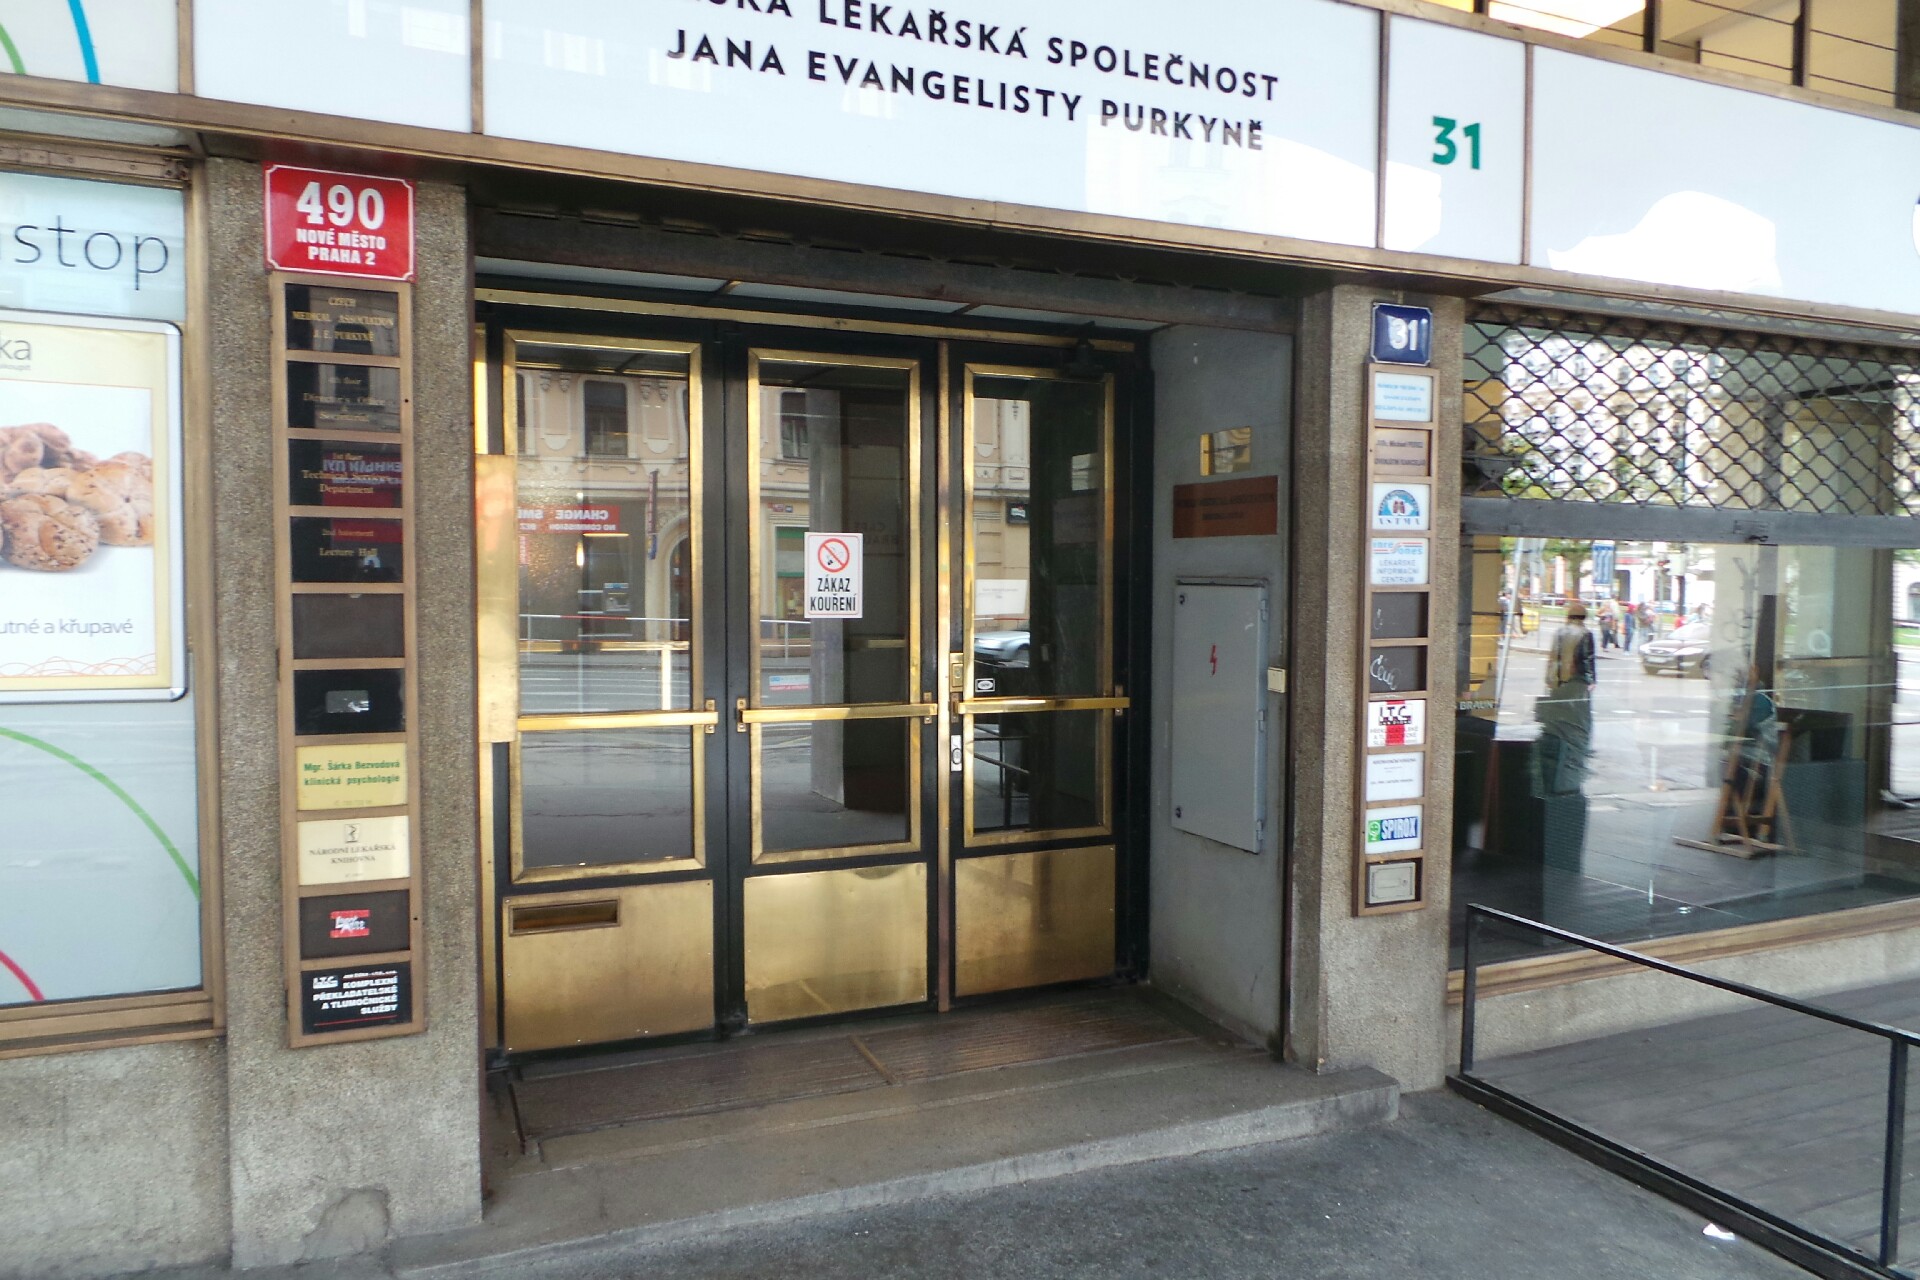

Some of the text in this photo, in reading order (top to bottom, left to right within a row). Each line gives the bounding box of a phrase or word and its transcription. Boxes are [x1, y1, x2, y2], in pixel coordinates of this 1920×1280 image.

[1047, 37, 1279, 102] SPOLEČNOST
[667, 29, 1265, 151] JANA EVANGELISTY PURKYNĚ
[1431, 115, 1481, 170] 31
[297, 182, 385, 229] 490
[296, 228, 386, 250] NOVÉ MĚSTO
[0, 215, 169, 291] stop
[309, 247, 376, 266] PRAHA 2
[1389, 317, 1419, 351] 31
[817, 575, 851, 594] ZÁKAZ
[810, 593, 857, 613] KOUŘENÍ
[43, 622, 55, 634] a
[59, 618, 134, 638] křupavé
[303, 762, 325, 773] Mgr.
[346, 774, 400, 786] psychologie
[330, 855, 376, 866] KNIHOVNA
[342, 976, 398, 989] KOMPLEXNÍ
[312, 985, 398, 1002] PŘEKLADATELSKÉ
[321, 994, 398, 1010] A TLUMOČNICKÉ
[360, 1004, 398, 1015] SLUŽBY
